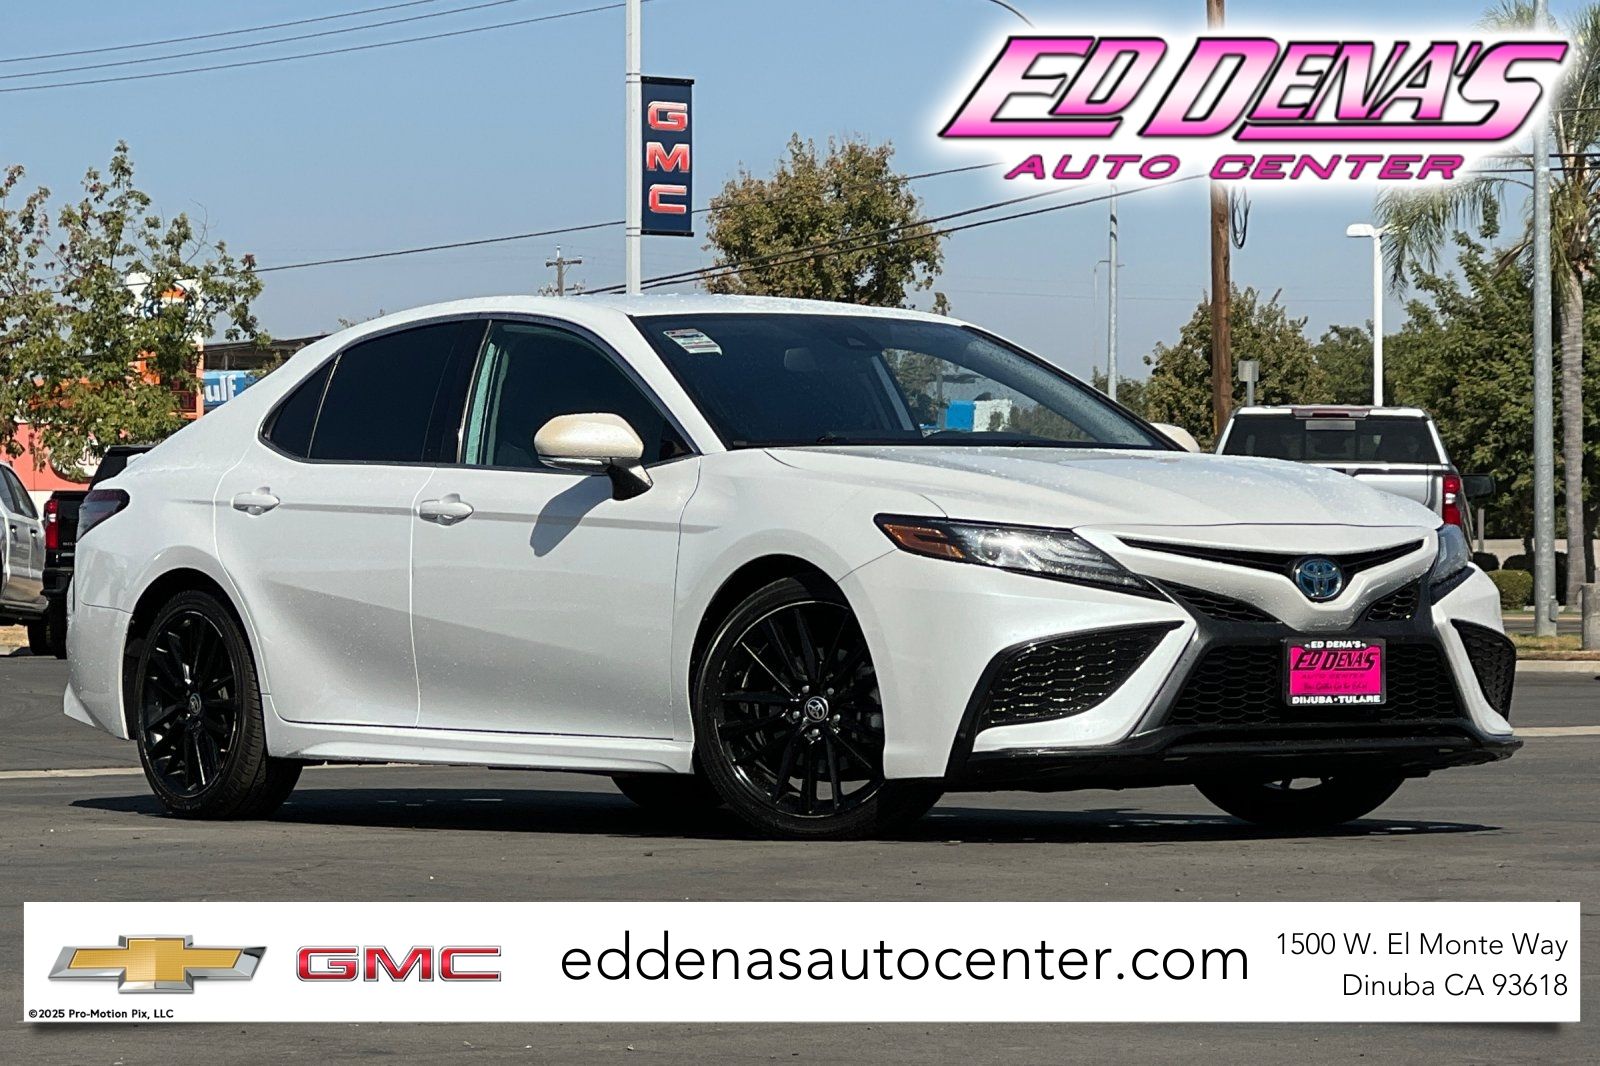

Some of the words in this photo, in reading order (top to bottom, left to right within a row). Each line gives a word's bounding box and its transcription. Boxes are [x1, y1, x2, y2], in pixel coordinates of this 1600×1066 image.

[647, 101, 690, 214] GMC
[203, 374, 237, 402] ulf
[1293, 652, 1321, 670] ED
[1292, 696, 1333, 704] DINUBA
[1338, 695, 1380, 703] TULARE
